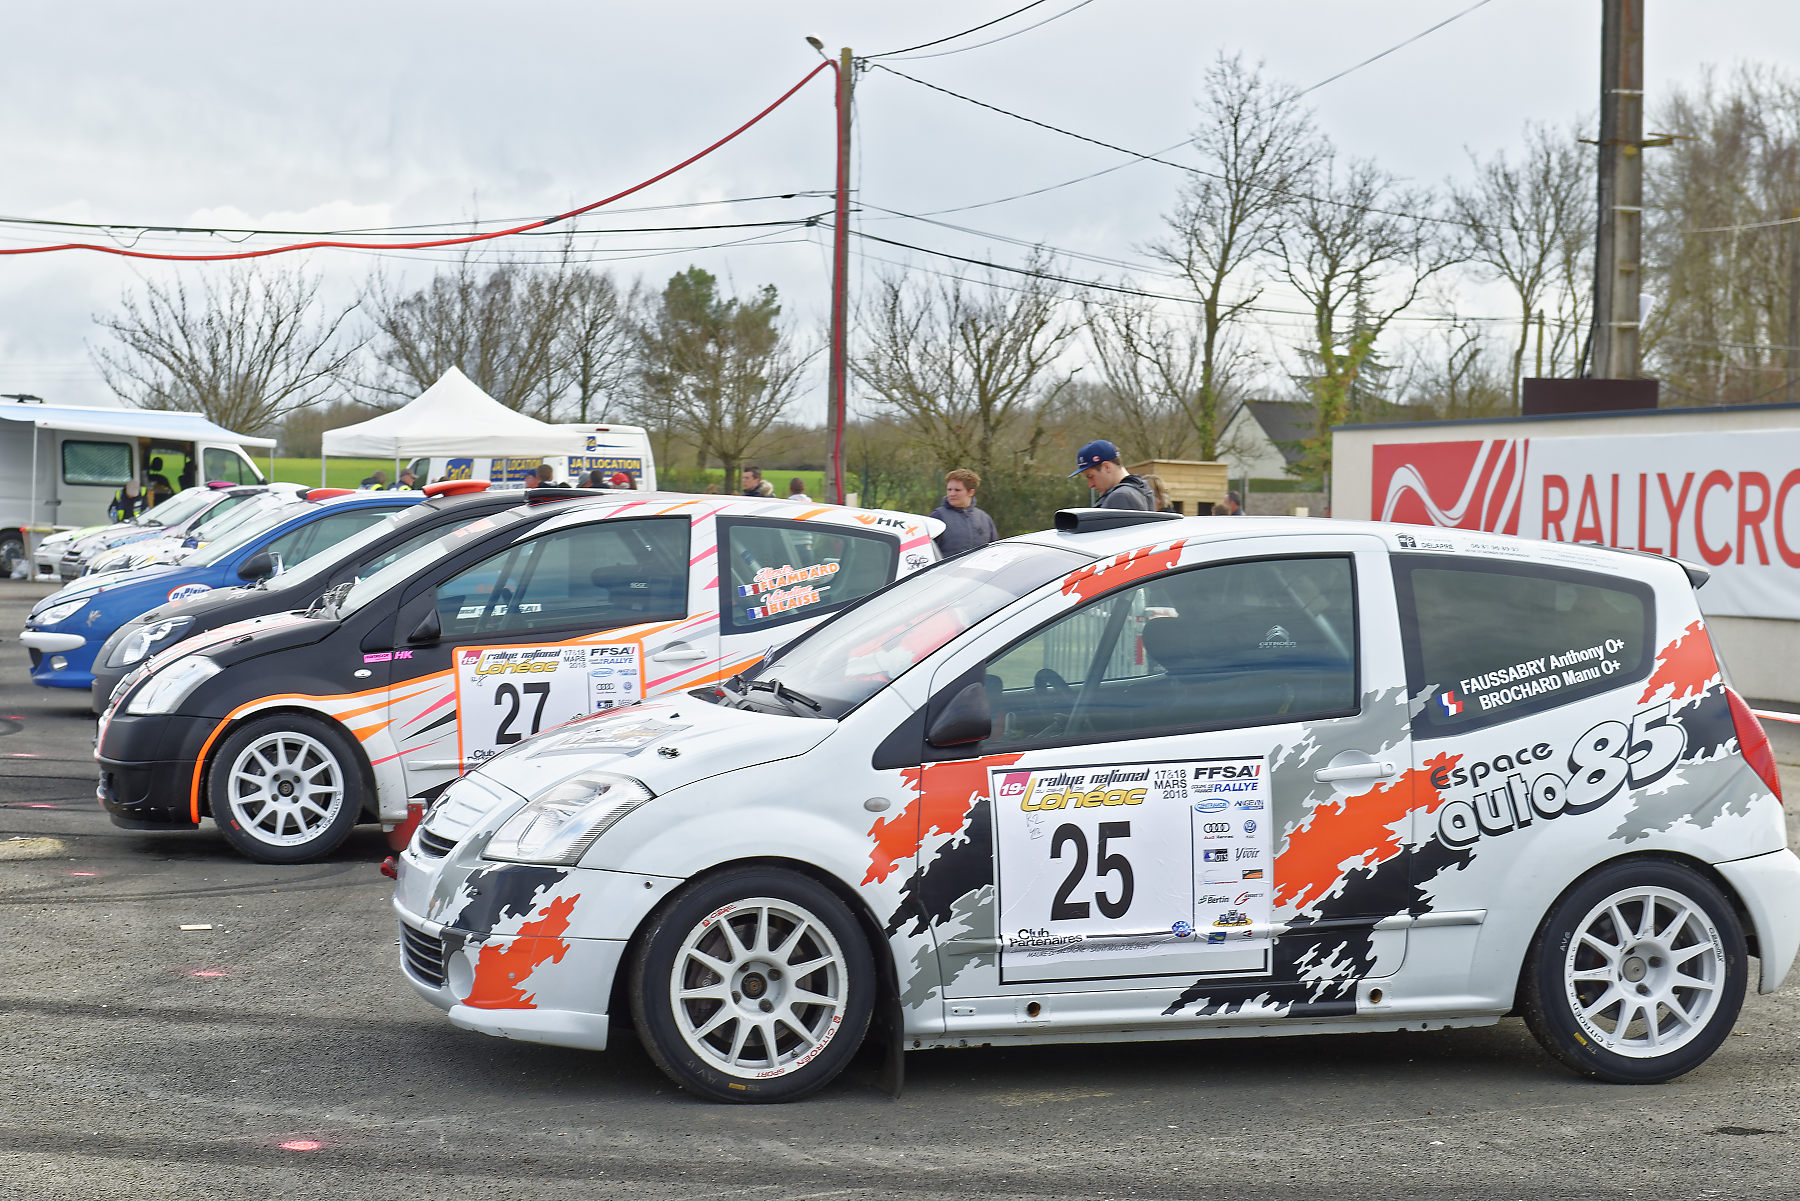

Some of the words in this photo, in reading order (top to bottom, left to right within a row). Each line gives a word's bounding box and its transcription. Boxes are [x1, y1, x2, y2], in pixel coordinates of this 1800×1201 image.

[592, 459, 640, 469] LOCATION
[760, 563, 840, 592] FLAMBARD
[769, 592, 821, 614] BLAISE
[394, 650, 414, 660] HK
[486, 652, 518, 661] rallye
[521, 649, 561, 658] national
[590, 647, 629, 656] FFSA
[475, 654, 559, 675] Lohéac
[1460, 658, 1546, 695] FAUSSABRY
[1549, 645, 1604, 670] Anthony
[1479, 674, 1562, 711] BROCHARD
[1561, 665, 1601, 686] Manu
[494, 682, 550, 745] 27
[1194, 765, 1253, 779] FFSA
[1431, 742, 1553, 790] Espace
[1037, 772, 1085, 788] rallye
[1089, 768, 1150, 787] national
[1154, 779, 1187, 789] MARS
[1163, 789, 1188, 799] 2018
[1214, 782, 1258, 792] RALLYE
[1021, 777, 1147, 812] Lohéac
[1050, 821, 1134, 921] 25
[1009, 934, 1083, 947] Partenaires
[1018, 928, 1049, 939] Club
[755, 1067, 785, 1078] SPORT
